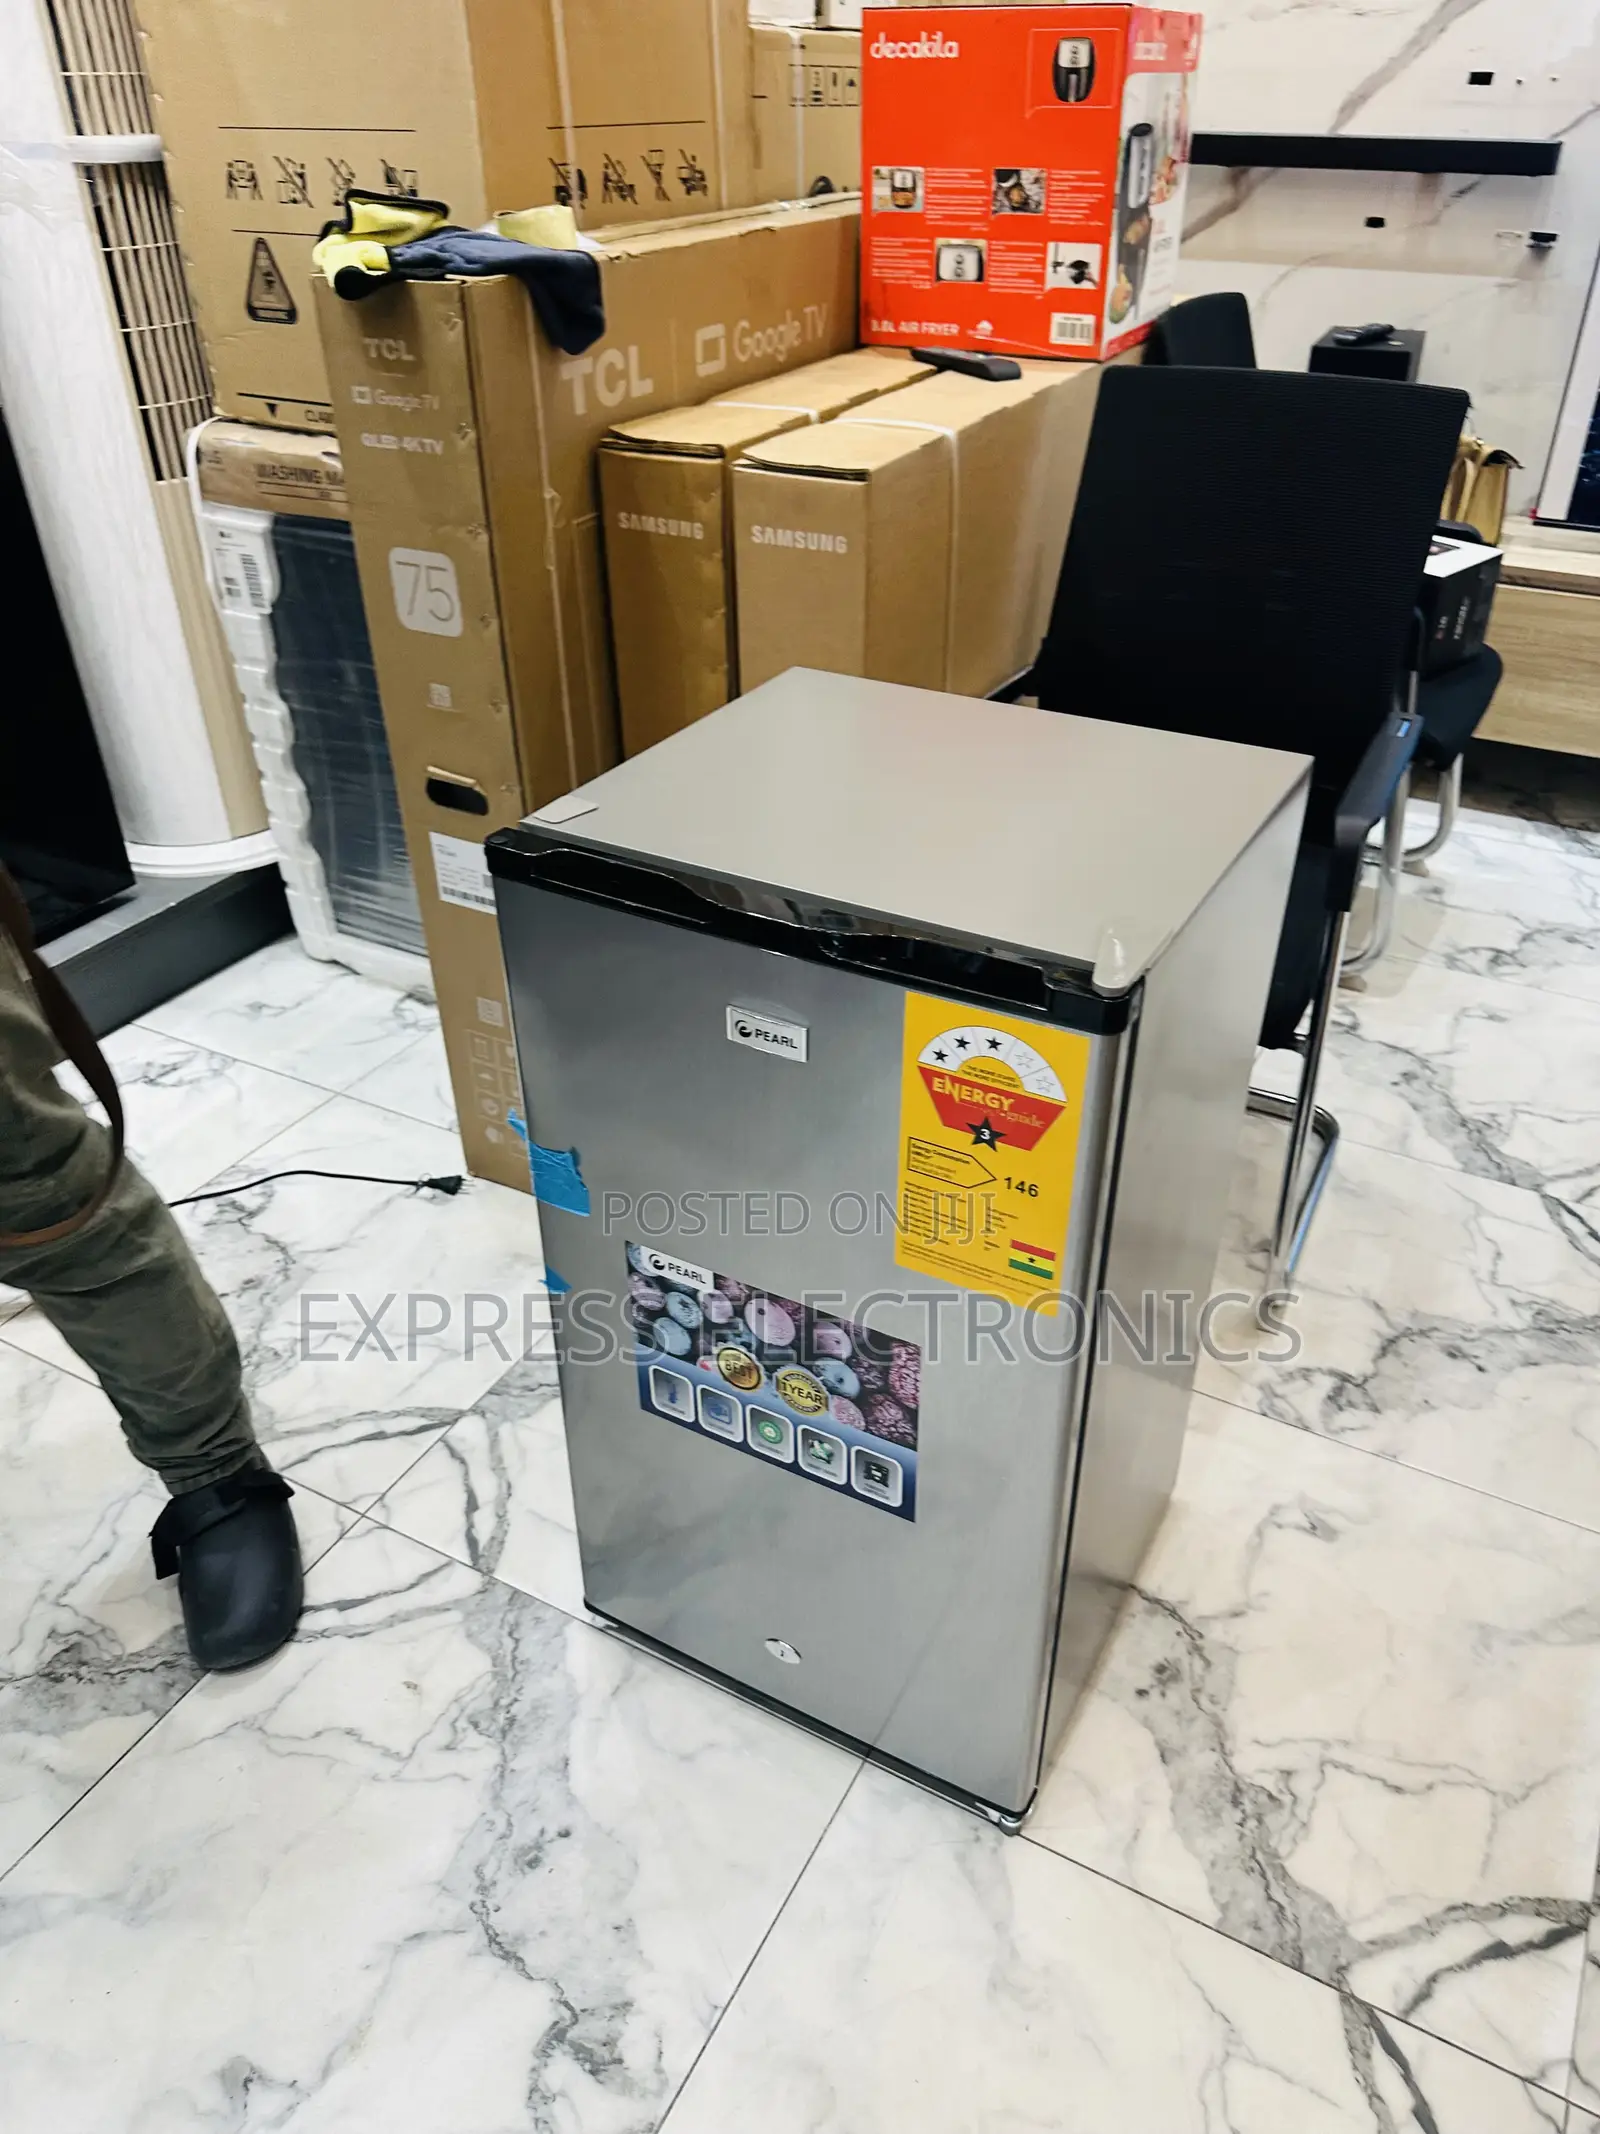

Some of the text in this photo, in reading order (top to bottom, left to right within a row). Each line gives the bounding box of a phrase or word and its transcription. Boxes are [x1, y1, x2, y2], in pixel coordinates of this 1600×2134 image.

[870, 31, 960, 59] decakila
[733, 303, 828, 363] Google TV
[920, 321, 960, 337] FRYER
[361, 337, 417, 361] TCL
[560, 345, 654, 416] TCL
[257, 463, 322, 484] WASHING
[617, 511, 704, 540] SAMSUNG
[751, 524, 848, 554] SAMSUNG
[394, 560, 455, 622] 75
[754, 1027, 799, 1050] PEARL
[931, 1075, 1015, 1111] ENERGY
[979, 1128, 992, 1141] 3
[1003, 1176, 1039, 1198] 146
[668, 1262, 707, 1285] PEARL
[724, 1359, 754, 1380] BEST
